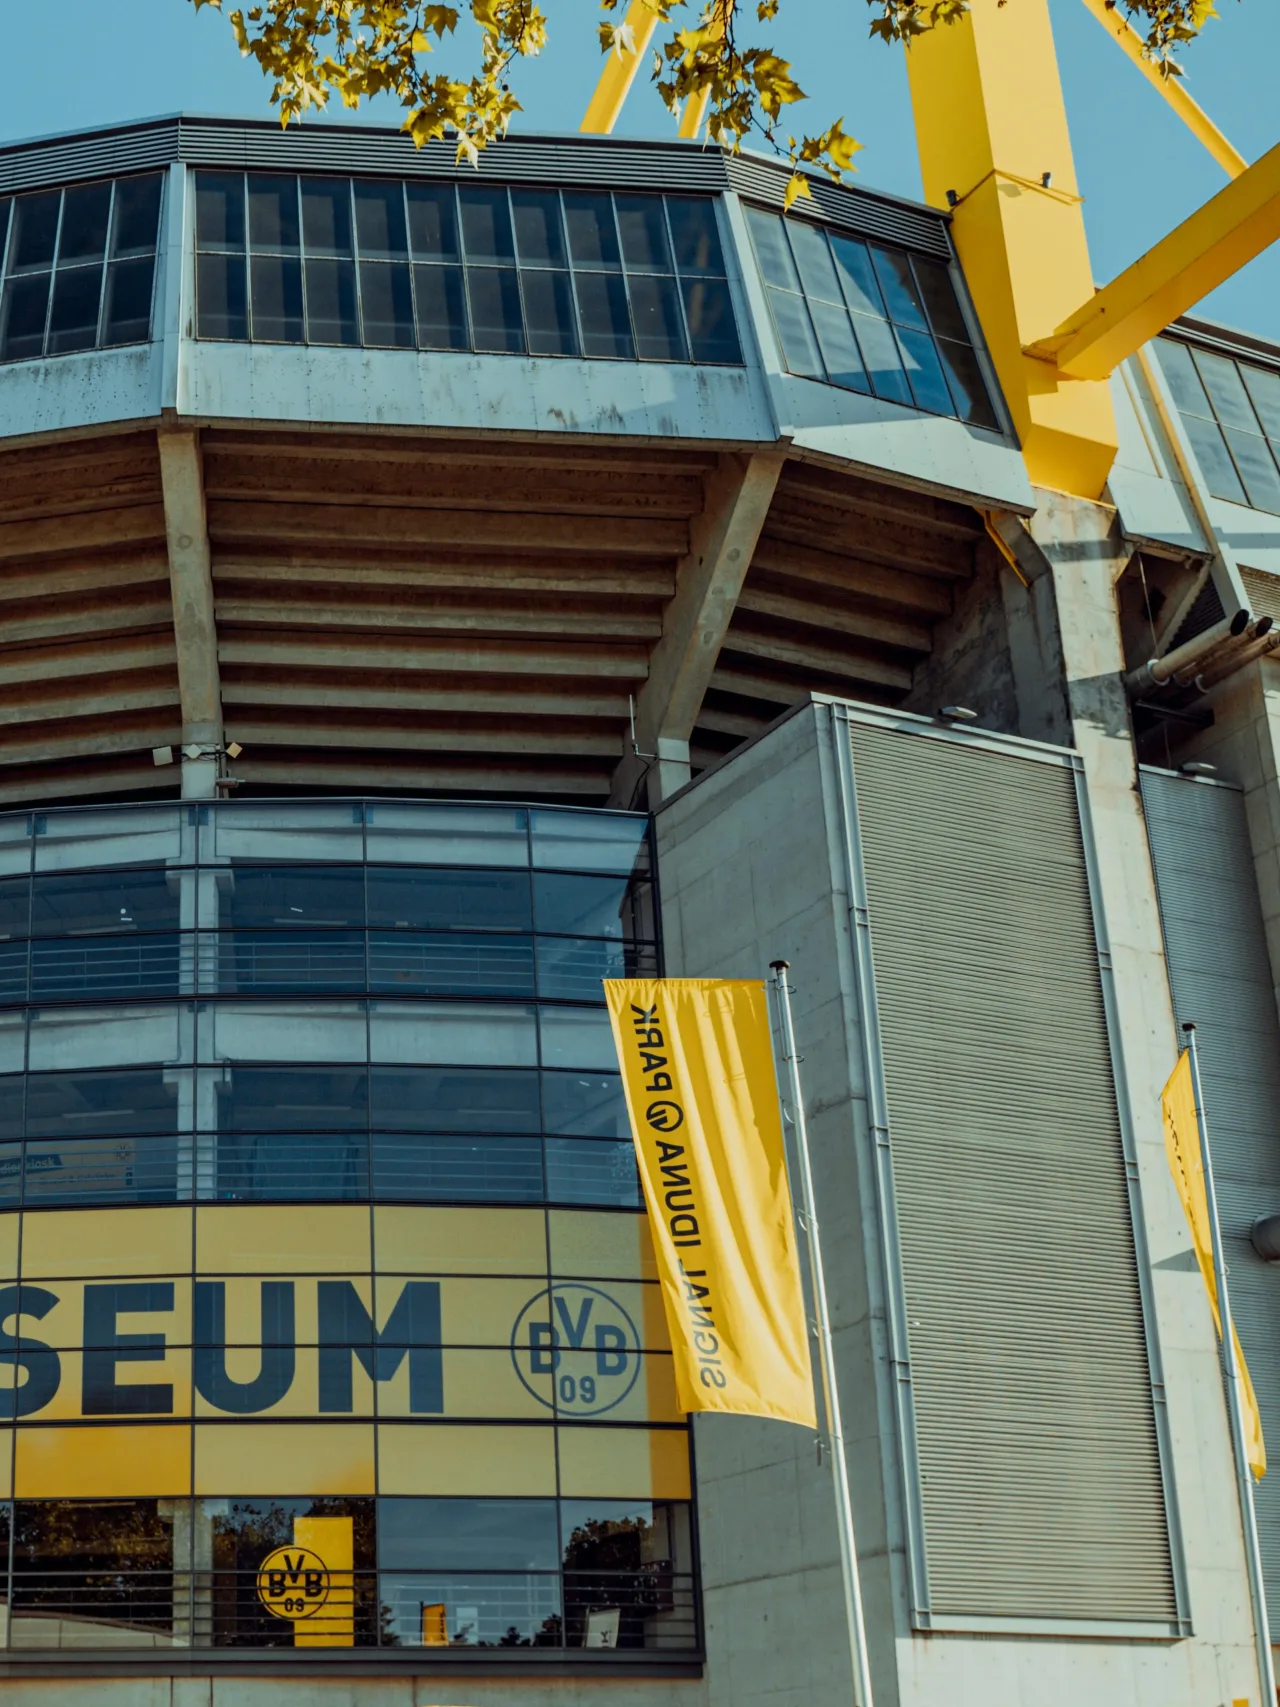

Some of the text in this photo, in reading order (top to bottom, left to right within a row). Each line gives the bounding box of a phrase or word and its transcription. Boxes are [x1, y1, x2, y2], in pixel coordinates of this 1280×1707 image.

[528, 1296, 628, 1376] BVB
[559, 1374, 596, 1404] 09
[268, 1554, 323, 1598] BVB
